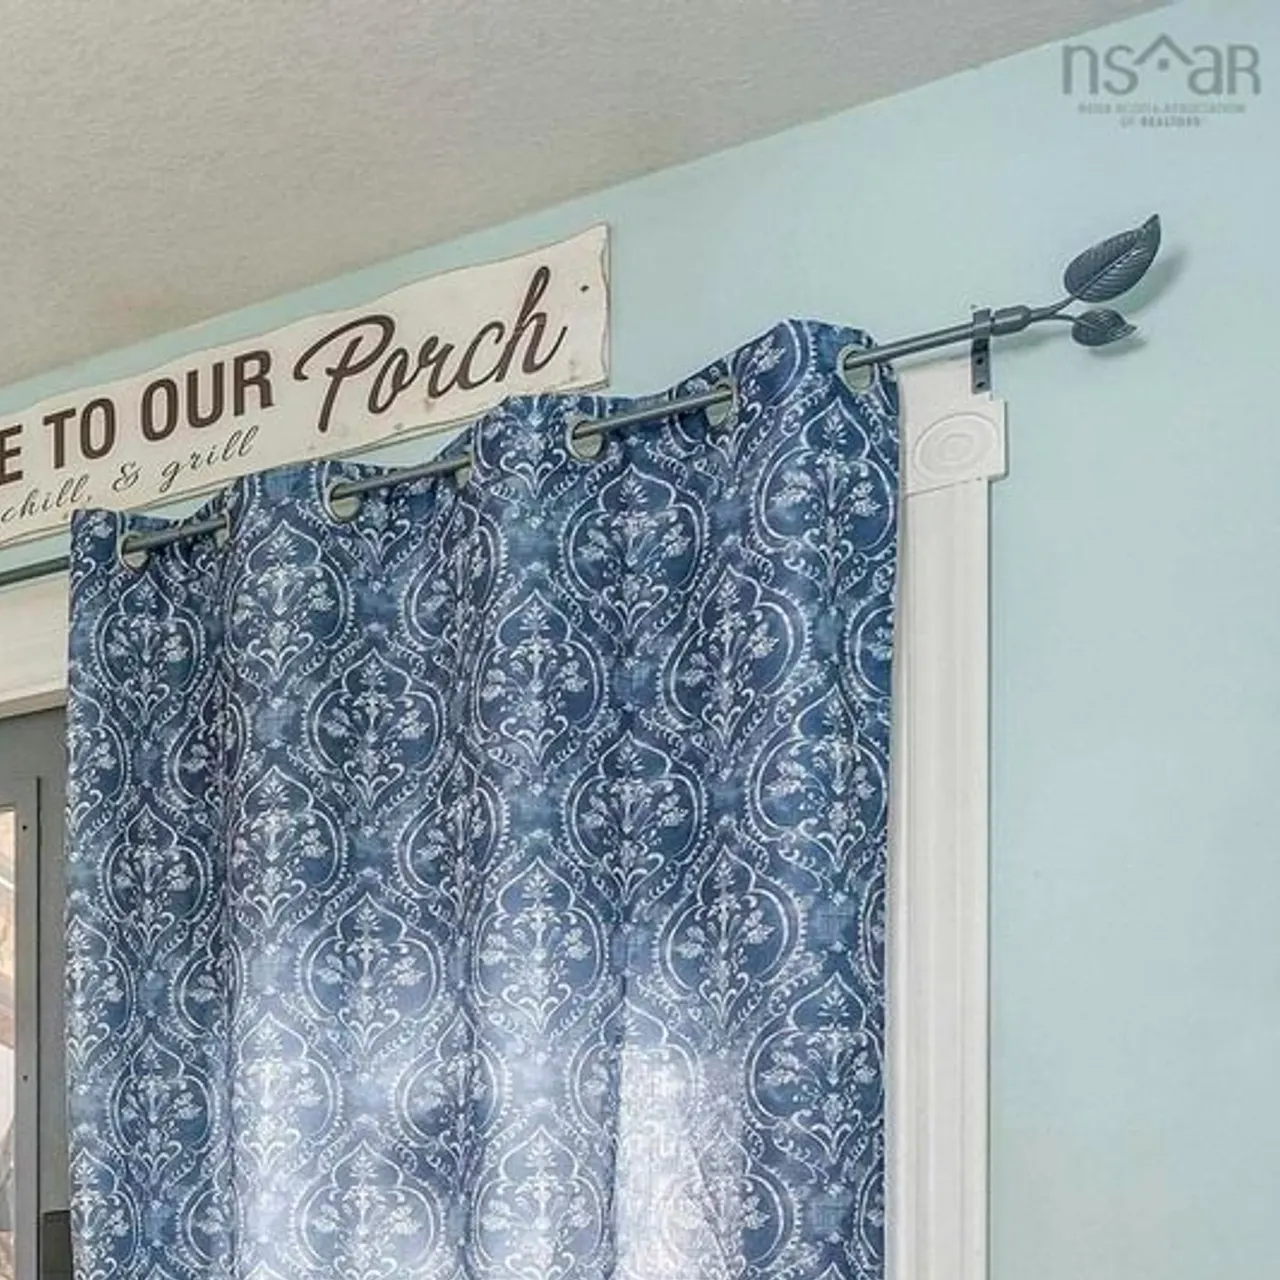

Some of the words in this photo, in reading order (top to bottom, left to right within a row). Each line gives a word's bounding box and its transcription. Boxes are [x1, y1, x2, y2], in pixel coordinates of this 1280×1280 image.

[43, 397, 116, 469] TO
[141, 350, 274, 441] OUR
[293, 266, 568, 433] Porch
[0, 473, 93, 523] chill,
[112, 461, 143, 492] &
[160, 425, 259, 493] grill
